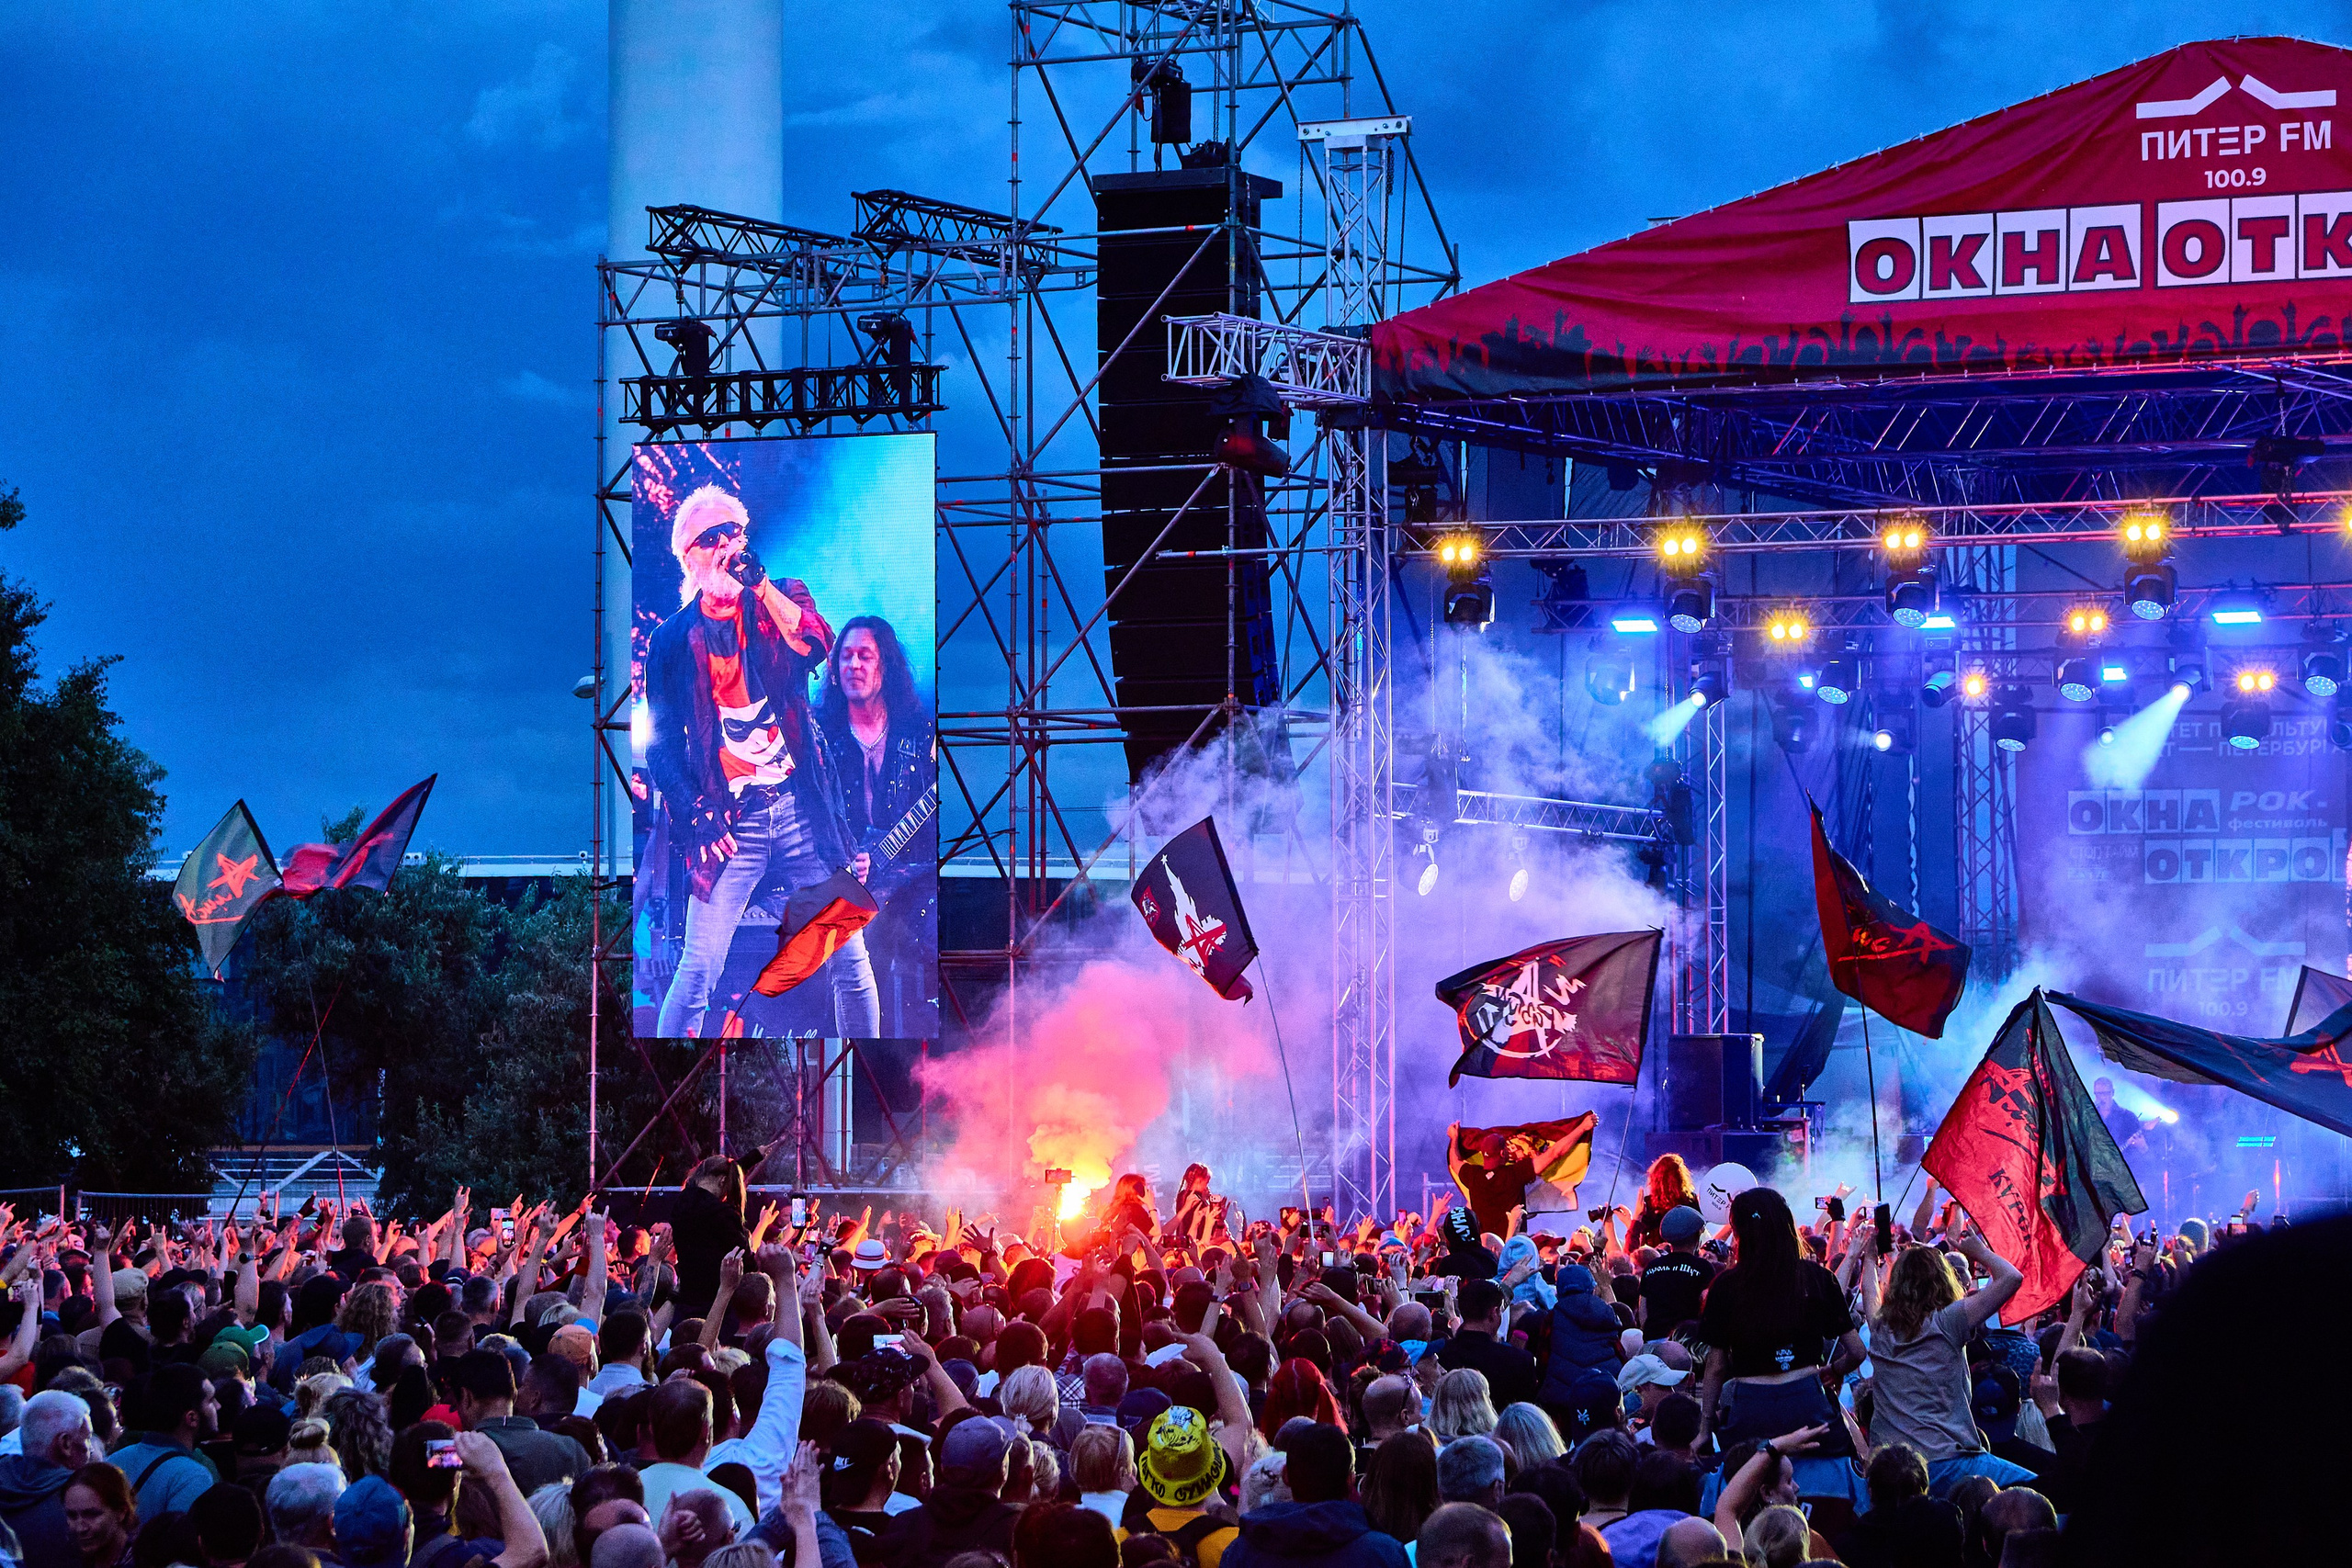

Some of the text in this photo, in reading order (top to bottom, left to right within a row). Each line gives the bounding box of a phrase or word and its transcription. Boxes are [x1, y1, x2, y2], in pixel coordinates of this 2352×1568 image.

[2141, 119, 2332, 162] ПИТЕР FM
[2204, 166, 2267, 189] 100.9
[1854, 224, 2137, 296] ОКНА
[2069, 797, 2219, 833] ОКНА
[2228, 817, 2328, 831] фестиваль
[2146, 846, 2346, 882] ОТКРО
[2147, 966, 2299, 994] ПИТЕР FM
[2199, 1000, 2248, 1017] 100.9
[1679, 1263, 1701, 1277] Шут
